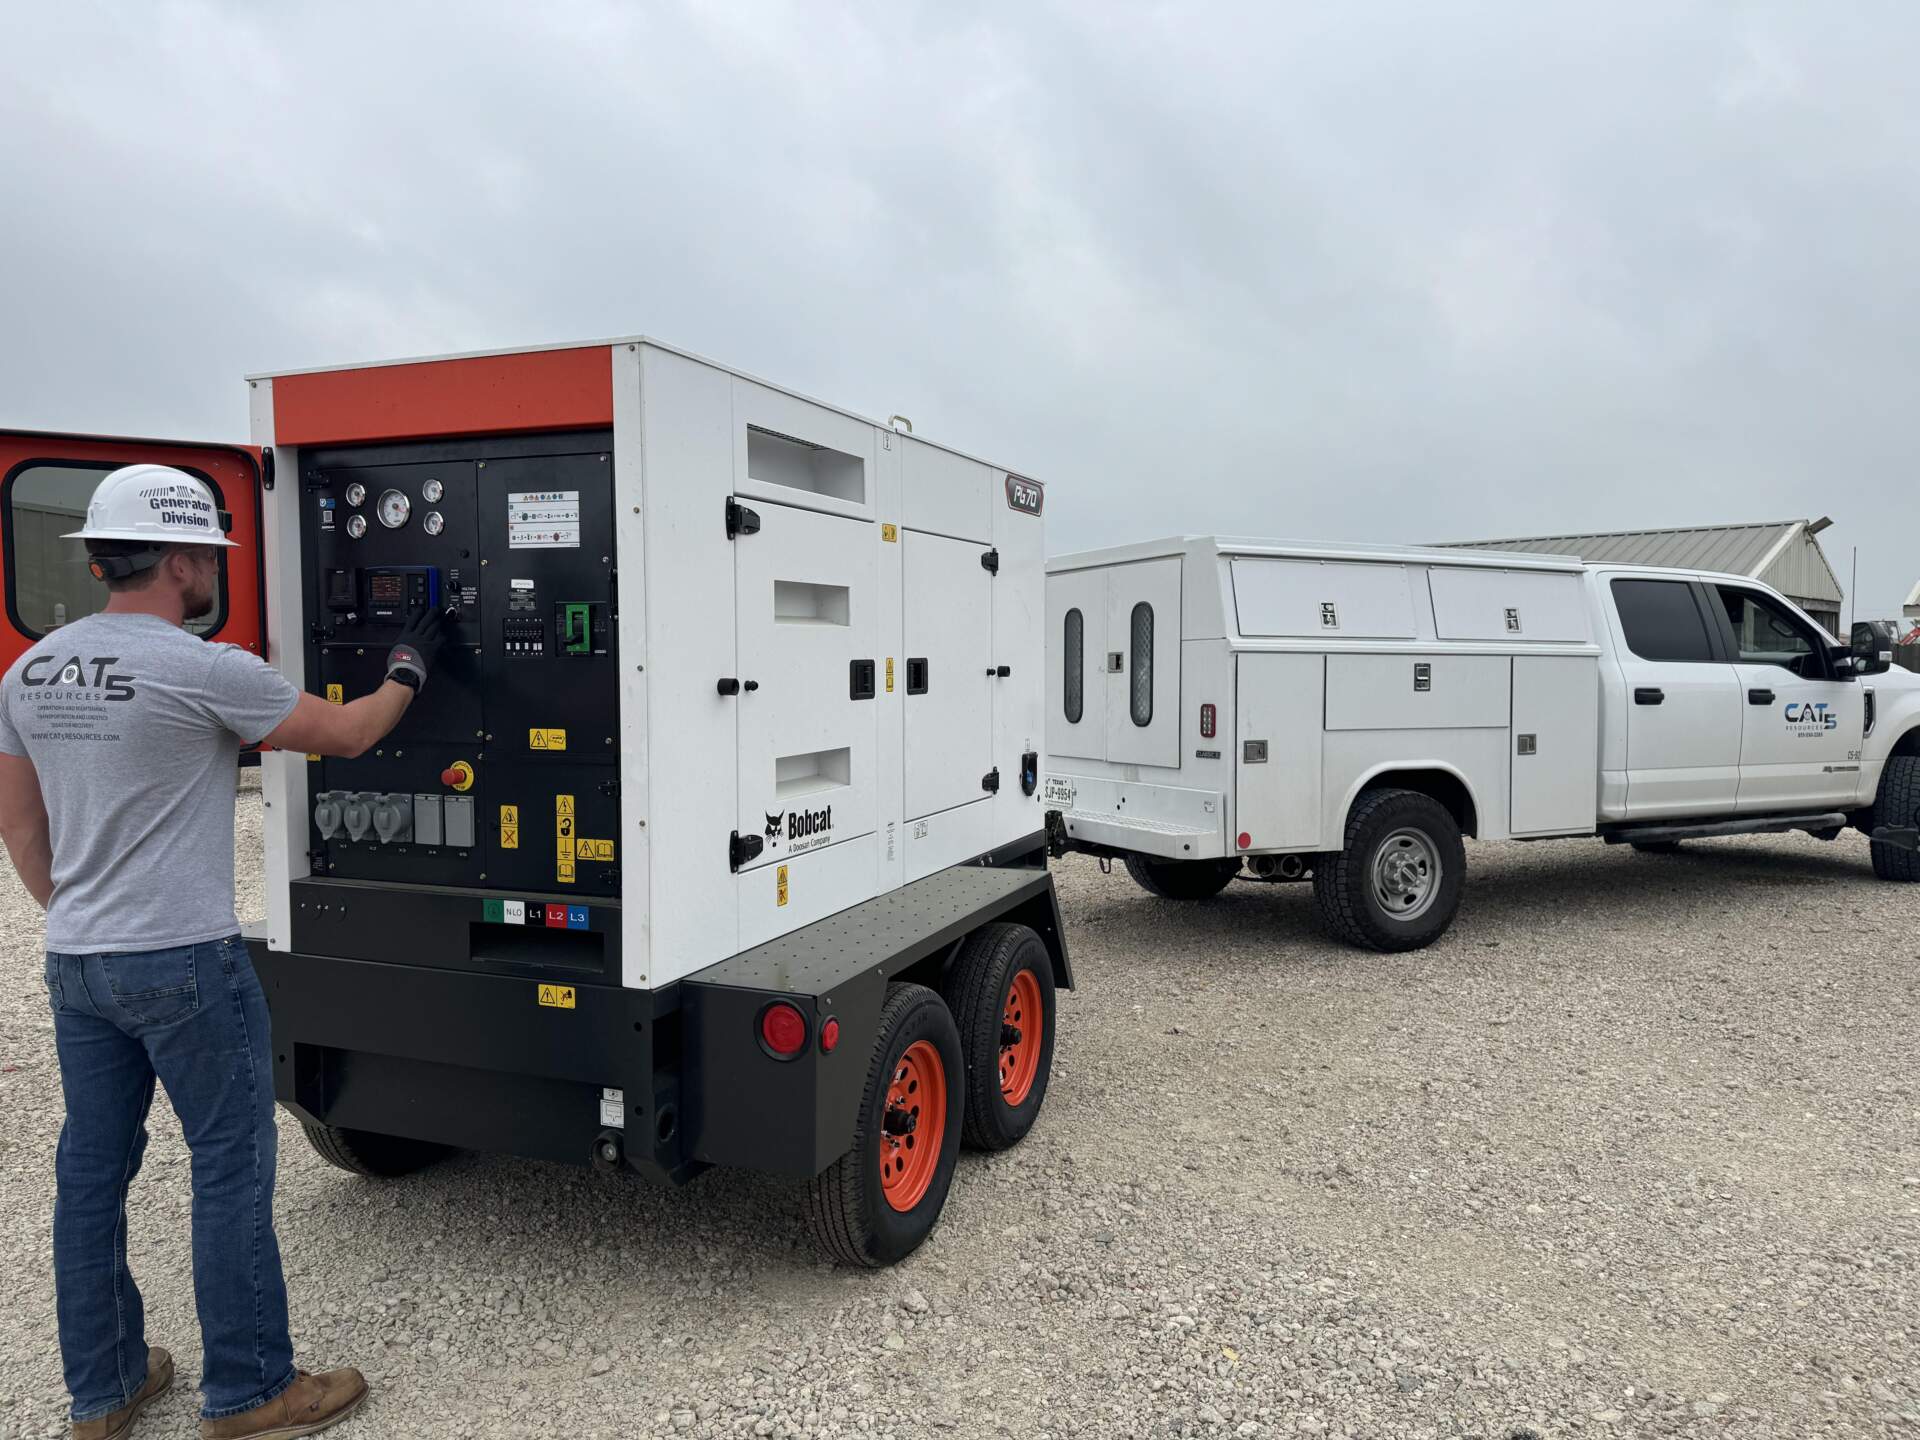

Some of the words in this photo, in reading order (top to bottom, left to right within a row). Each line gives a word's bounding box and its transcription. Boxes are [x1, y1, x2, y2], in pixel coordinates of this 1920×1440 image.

[149, 498, 211, 512] Generator
[162, 511, 209, 527] Division
[20, 692, 101, 701] RESOURCES
[31, 732, 121, 741] WWW.CAT5RESOURCES.COM
[788, 804, 831, 840] Bobcat
[788, 845, 793, 853] A
[793, 841, 810, 852] Doosan
[810, 836, 831, 848] Company
[529, 909, 541, 919] L1
[548, 911, 564, 921] L2
[570, 913, 585, 922] L3
